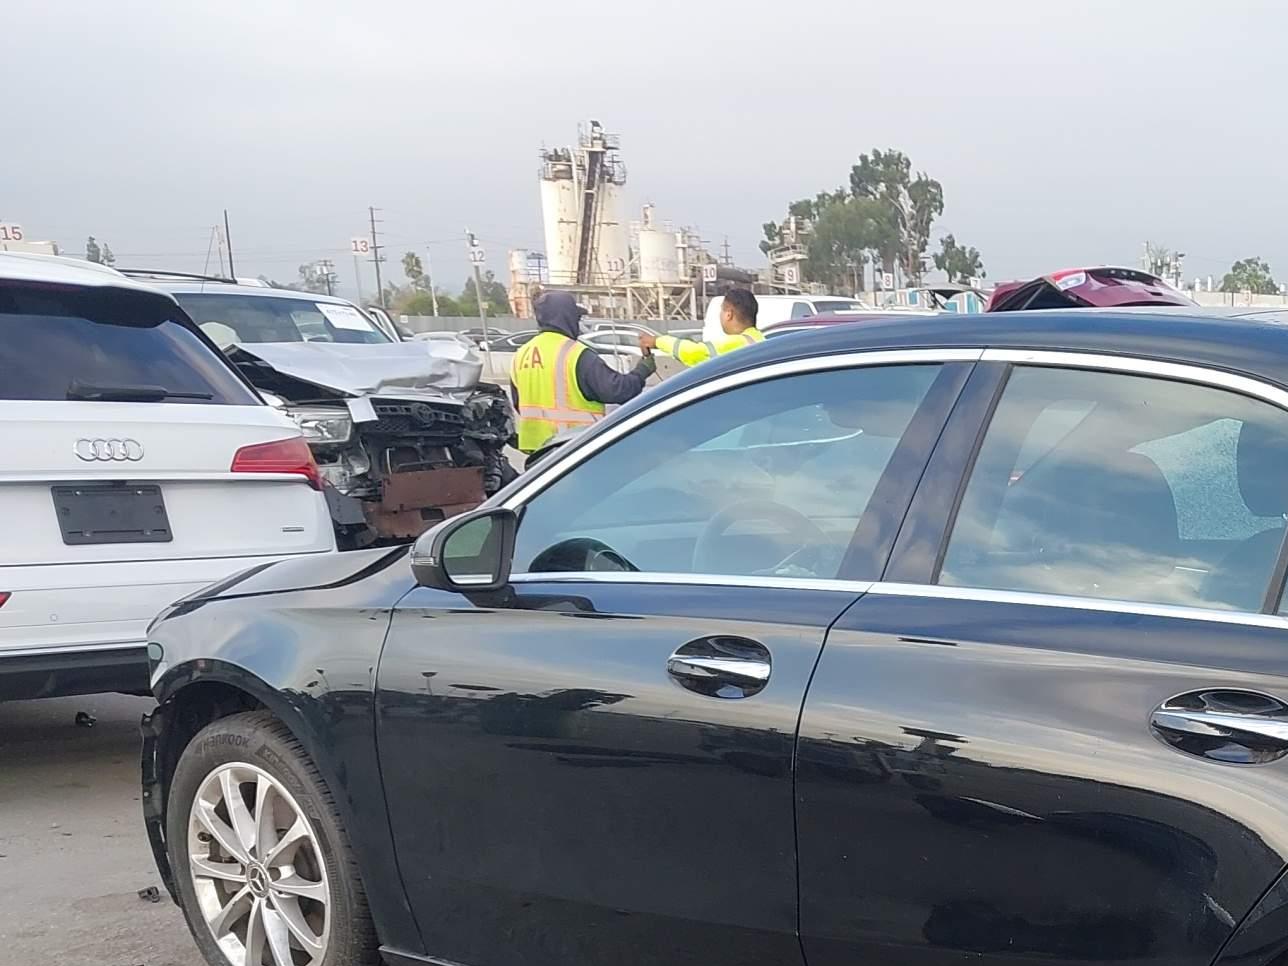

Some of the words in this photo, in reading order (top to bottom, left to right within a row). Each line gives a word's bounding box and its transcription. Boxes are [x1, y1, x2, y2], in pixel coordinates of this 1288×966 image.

[0, 226, 22, 240] 15
[352, 240, 368, 252] 13
[471, 251, 485, 262] 12
[608, 261, 619, 271] 11
[704, 268, 715, 278] 10
[788, 269, 793, 281] 9
[884, 275, 891, 286] 8
